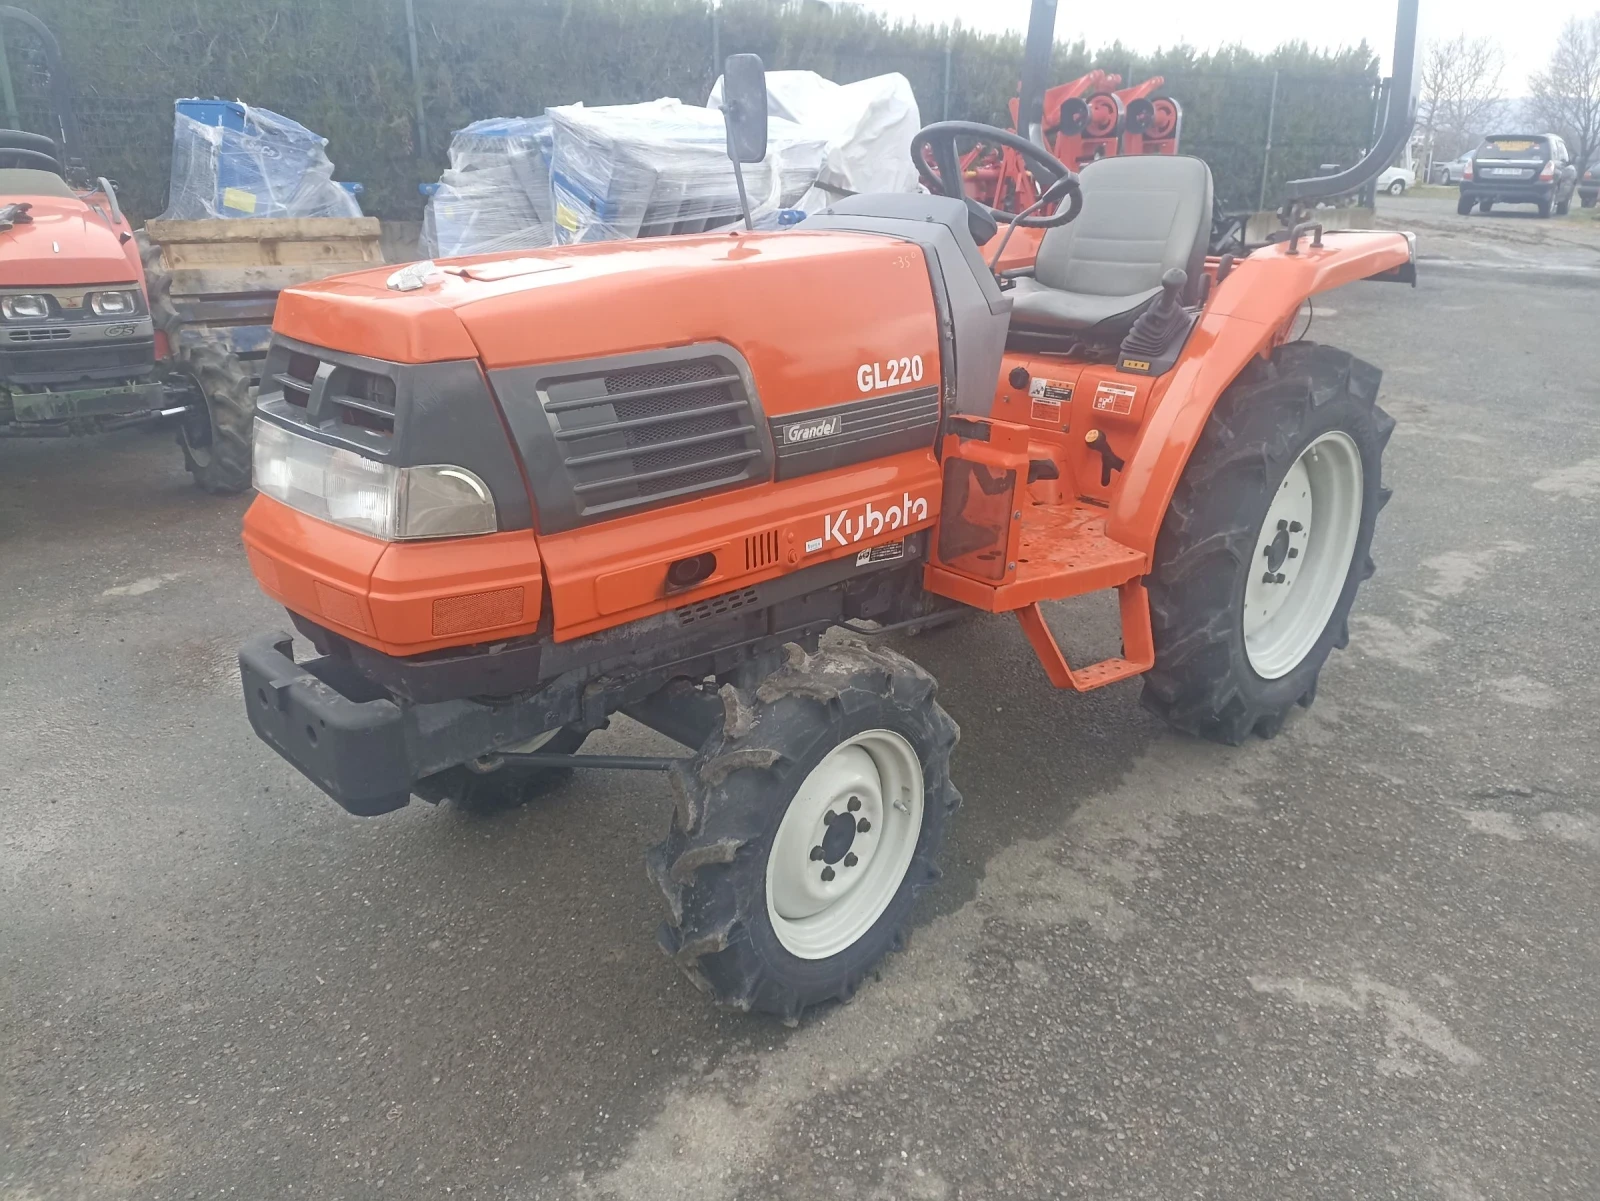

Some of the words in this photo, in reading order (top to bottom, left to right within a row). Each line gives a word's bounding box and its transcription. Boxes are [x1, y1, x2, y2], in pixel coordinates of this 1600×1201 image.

[857, 354, 924, 392] GL220
[788, 417, 837, 442] Grandel
[824, 492, 928, 546] Kubota
